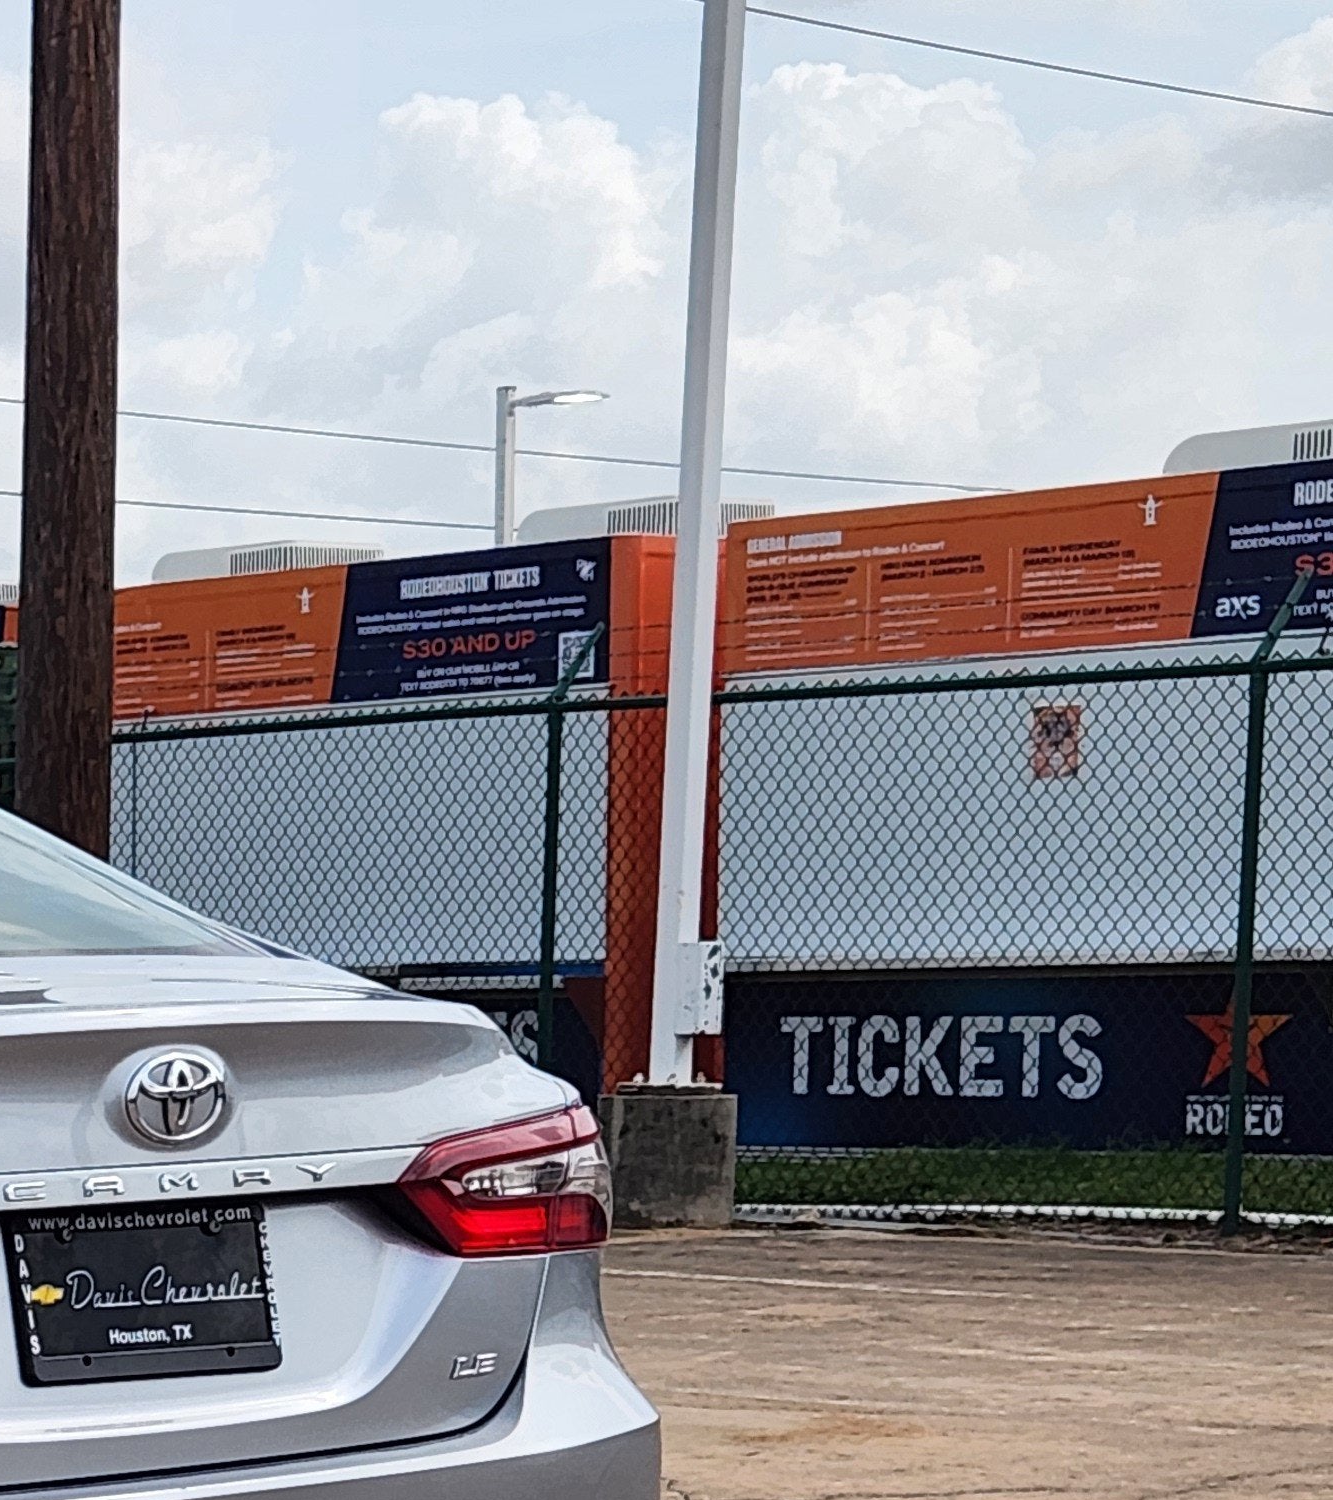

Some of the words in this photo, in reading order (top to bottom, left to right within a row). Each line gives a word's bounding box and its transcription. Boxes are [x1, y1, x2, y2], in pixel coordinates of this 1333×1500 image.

[1215, 595, 1261, 620] axs
[451, 632, 501, 655] AND
[505, 629, 537, 651] UP
[780, 1013, 1103, 1100] TICKETS
[4, 1161, 337, 1202] CAMRY
[13, 1234, 42, 1356] DAVIS
[66, 1270, 141, 1309] Davis
[140, 1265, 265, 1305] Chevrolet
[109, 1328, 171, 1345] Houston,
[172, 1324, 193, 1341] TX
[449, 1352, 499, 1380] LE
